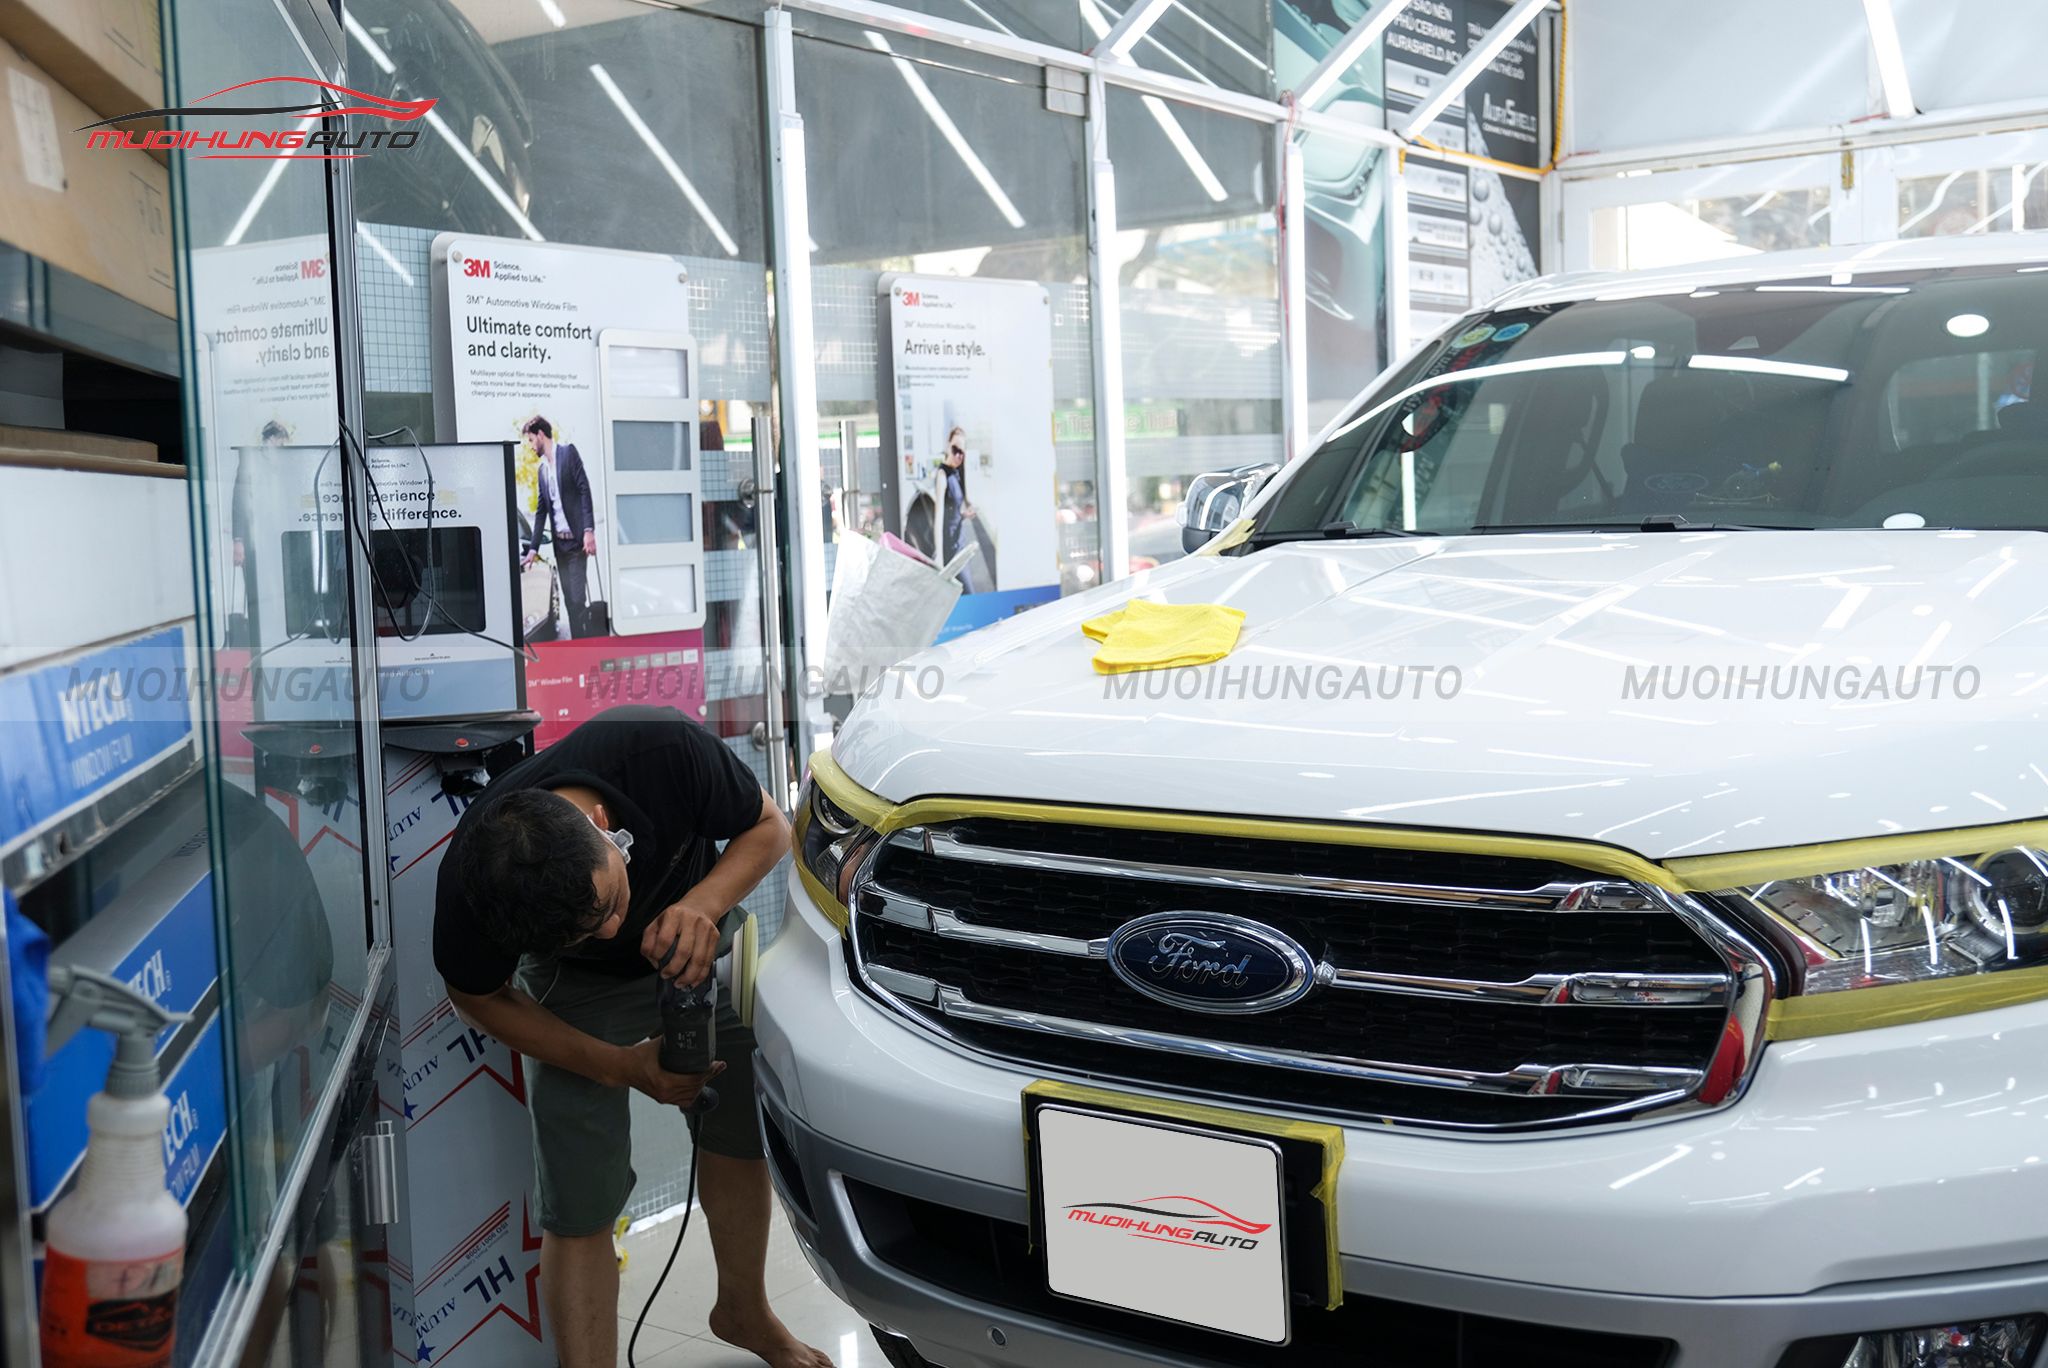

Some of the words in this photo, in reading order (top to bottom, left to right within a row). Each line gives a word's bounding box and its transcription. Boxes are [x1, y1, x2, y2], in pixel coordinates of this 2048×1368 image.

[464, 258, 490, 278] 3M
[494, 272, 520, 282] Applied
[486, 297, 529, 308] Automotive
[531, 300, 561, 311] Window
[563, 302, 578, 312] Film
[902, 291, 920, 306] 3M
[467, 316, 531, 336] Ultimate
[535, 322, 592, 340] comfort
[468, 340, 496, 357] and
[500, 341, 551, 364] clarity.
[904, 338, 940, 355] Arrive
[942, 339, 953, 355] in
[955, 340, 986, 359] style.
[1148, 932, 1252, 986] Ford
[463, 1254, 515, 1304] HL
